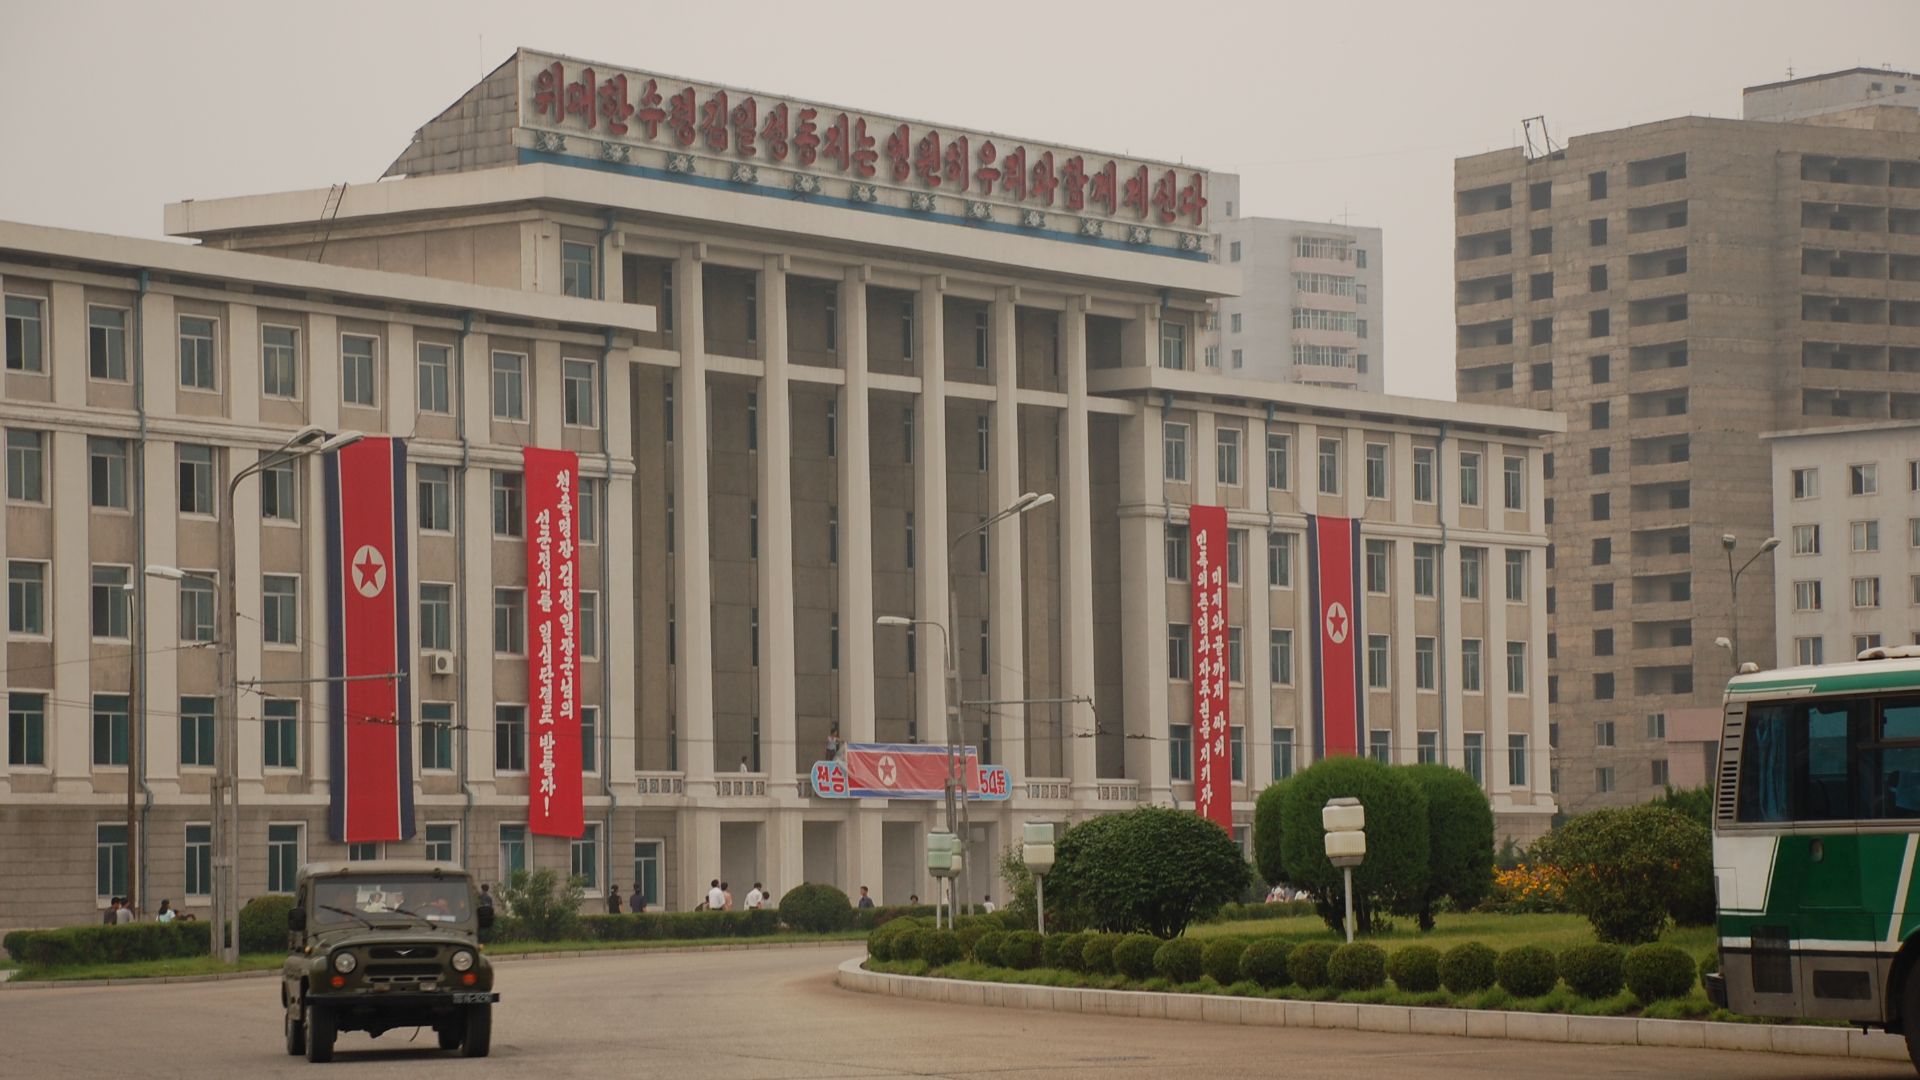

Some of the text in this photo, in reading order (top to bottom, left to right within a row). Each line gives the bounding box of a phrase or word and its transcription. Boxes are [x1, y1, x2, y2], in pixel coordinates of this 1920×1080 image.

[534, 60, 634, 135] 위대한
[638, 78, 696, 146] 수령
[702, 90, 879, 177] 김일성동지는
[887, 123, 969, 192] 영원히
[976, 139, 1059, 208] 우리와
[1063, 155, 1118, 216] 함께
[555, 469, 574, 559] 천출명장
[1196, 528, 1208, 590] 민족의
[535, 508, 556, 817] 선군정치를 일심단결로 받들자!
[1197, 592, 1210, 656] 존엄과
[1198, 657, 1211, 740] 자주권을
[817, 765, 845, 793] 전승
